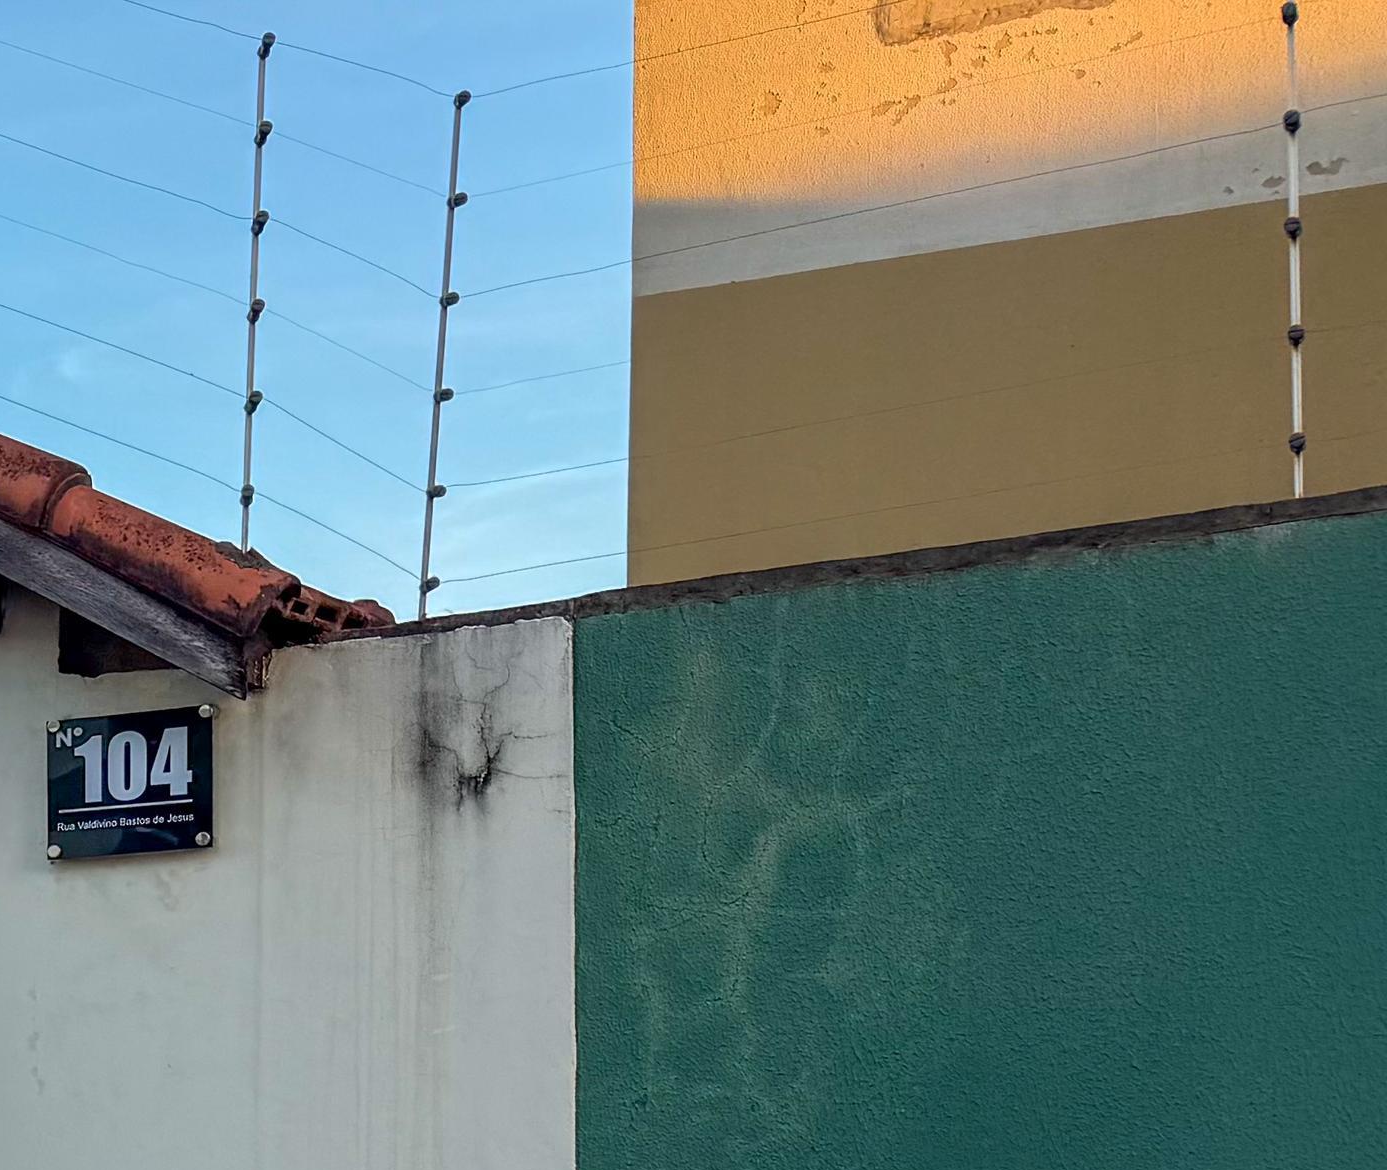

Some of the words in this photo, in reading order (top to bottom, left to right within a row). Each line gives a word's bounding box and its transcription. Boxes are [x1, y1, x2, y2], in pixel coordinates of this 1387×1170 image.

[74, 726, 193, 803] 104
[57, 822, 75, 831] Rua
[78, 819, 117, 830] Valdivino
[120, 817, 150, 827] Bastos
[153, 815, 164, 824] de
[167, 813, 194, 823] Jesus
